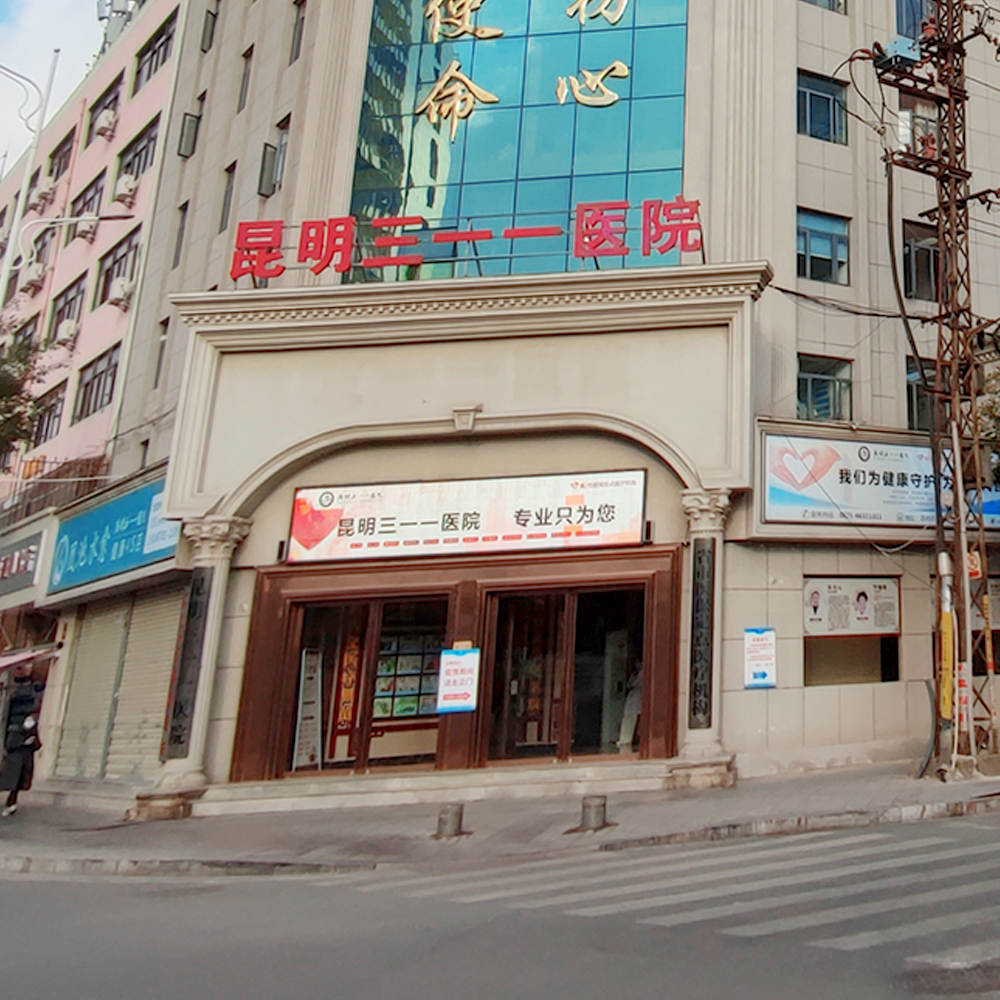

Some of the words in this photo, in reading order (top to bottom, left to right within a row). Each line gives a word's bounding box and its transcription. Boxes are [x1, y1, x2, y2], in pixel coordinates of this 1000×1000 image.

[230, 195, 702, 281] 昆明三一一医院
[337, 511, 481, 538] 昆明三一一医院
[513, 504, 617, 528] 专业只为您
